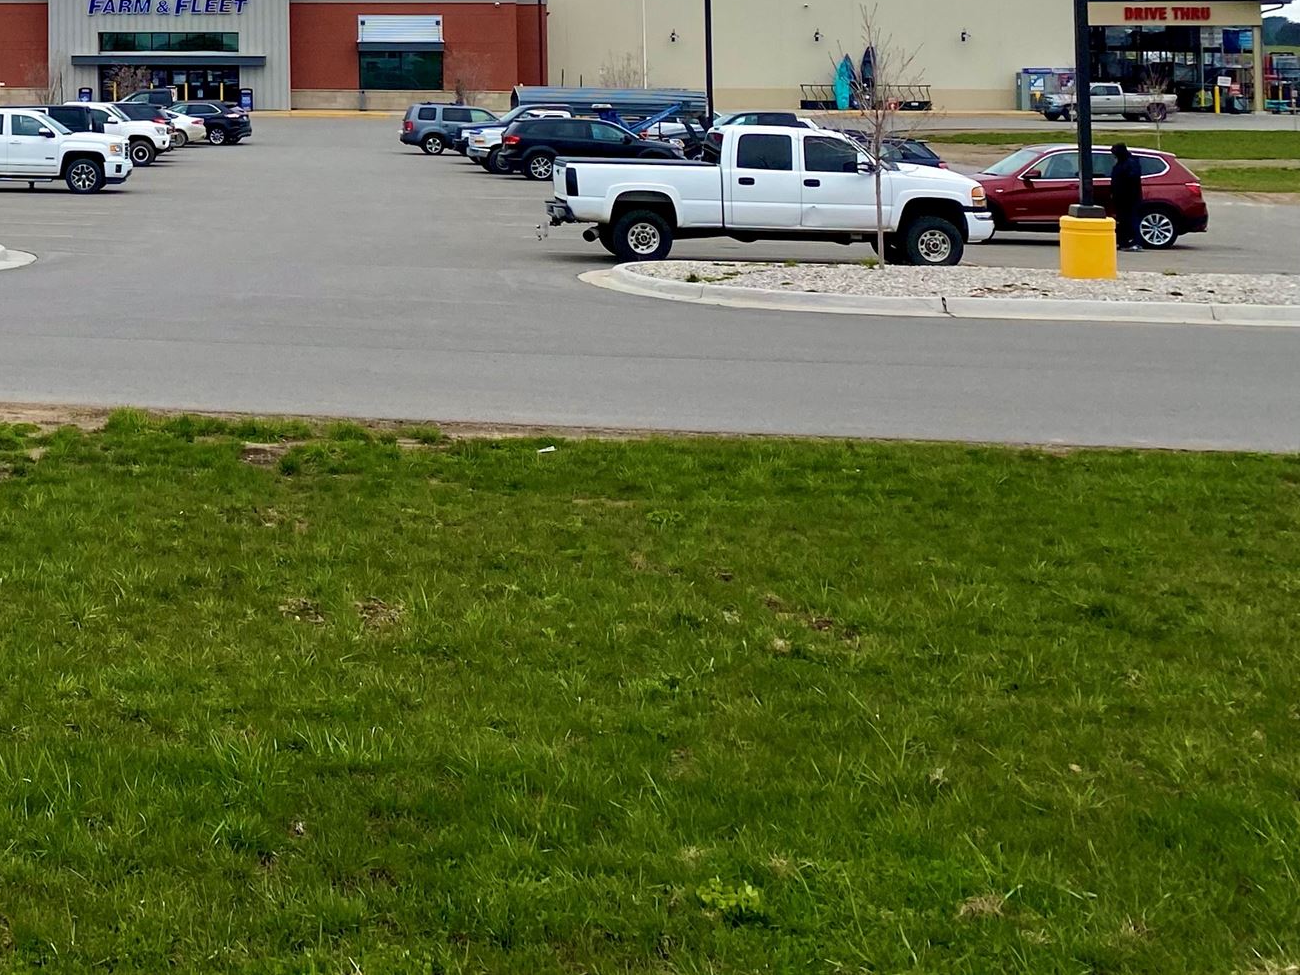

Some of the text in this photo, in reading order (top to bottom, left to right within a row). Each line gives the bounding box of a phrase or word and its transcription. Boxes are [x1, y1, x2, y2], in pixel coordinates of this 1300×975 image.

[156, 0, 171, 15] &
[1123, 6, 1211, 21] DRIVE THRU
